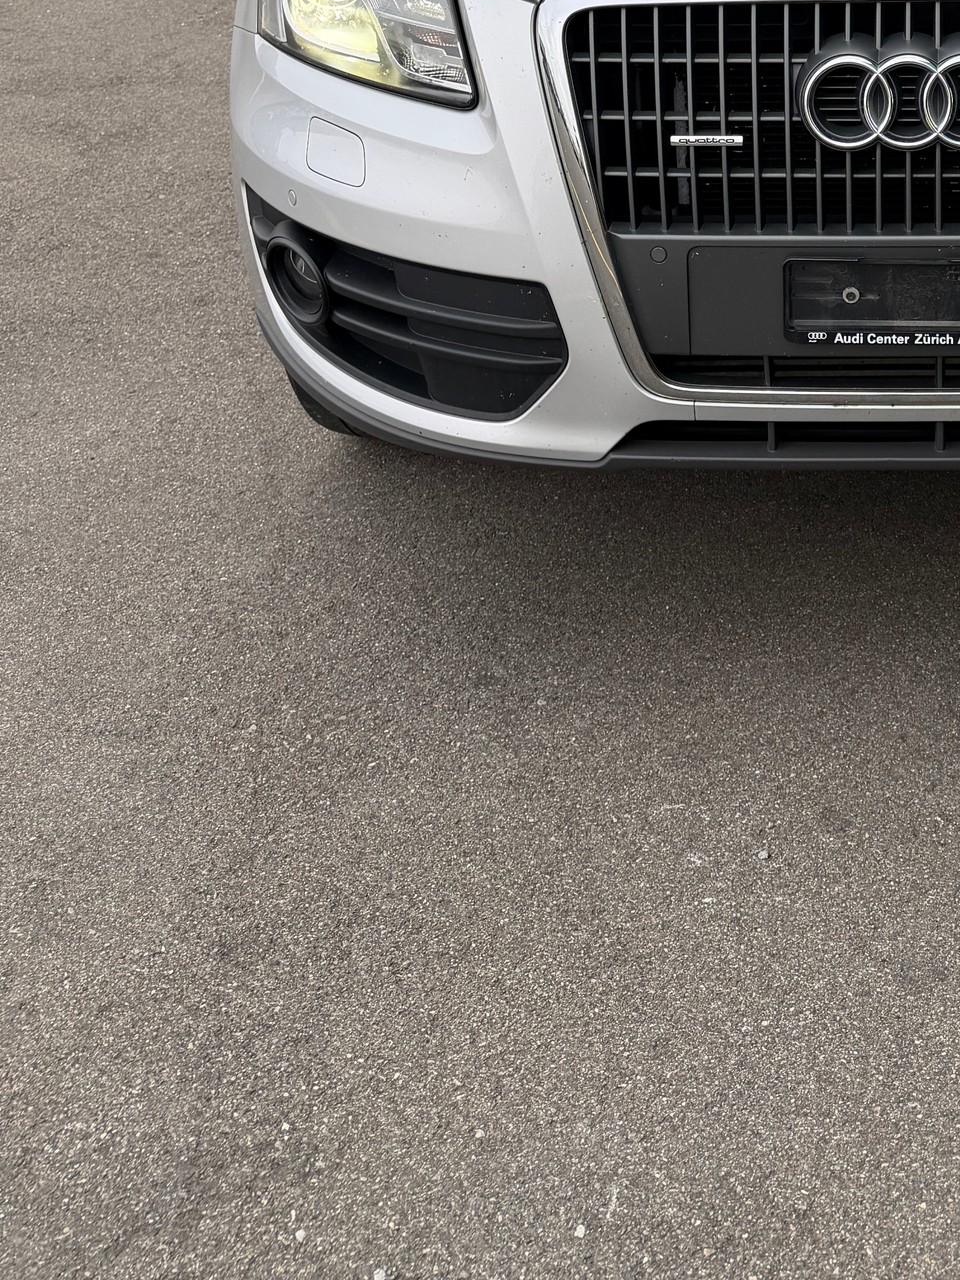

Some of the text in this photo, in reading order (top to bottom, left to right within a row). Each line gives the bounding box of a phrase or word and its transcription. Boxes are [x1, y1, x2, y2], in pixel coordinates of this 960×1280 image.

[678, 137, 735, 145] quattro
[833, 332, 864, 344] Audi
[866, 333, 910, 345] Center
[914, 333, 954, 345] Zürich
